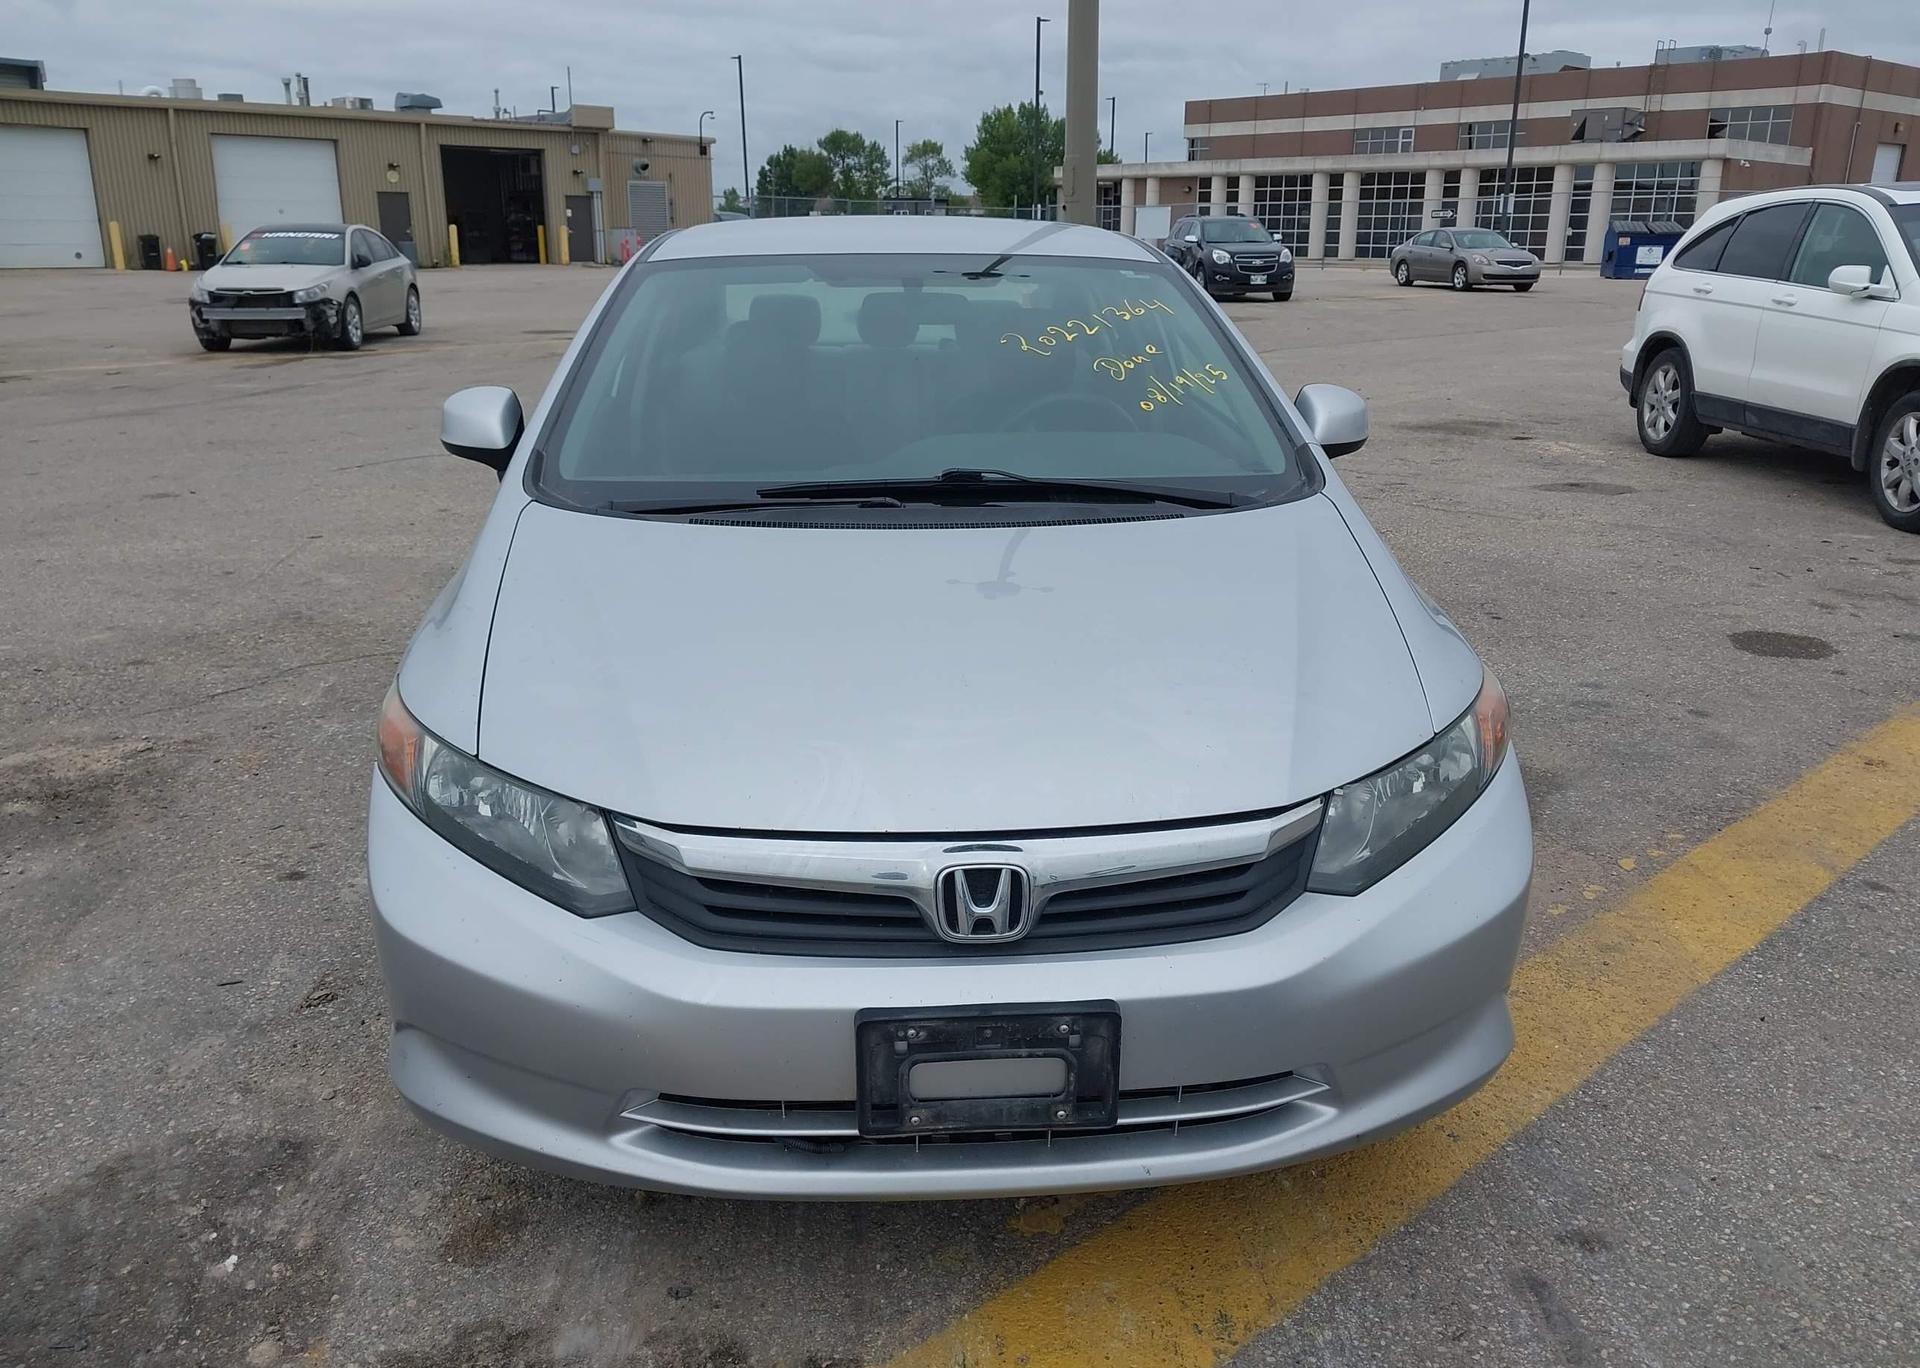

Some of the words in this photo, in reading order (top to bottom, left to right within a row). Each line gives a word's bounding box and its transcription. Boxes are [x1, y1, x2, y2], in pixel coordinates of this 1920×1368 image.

[1000, 299, 1175, 356] 20221364
[1093, 344, 1164, 381] Done
[1140, 363, 1228, 411] 08/19/25
